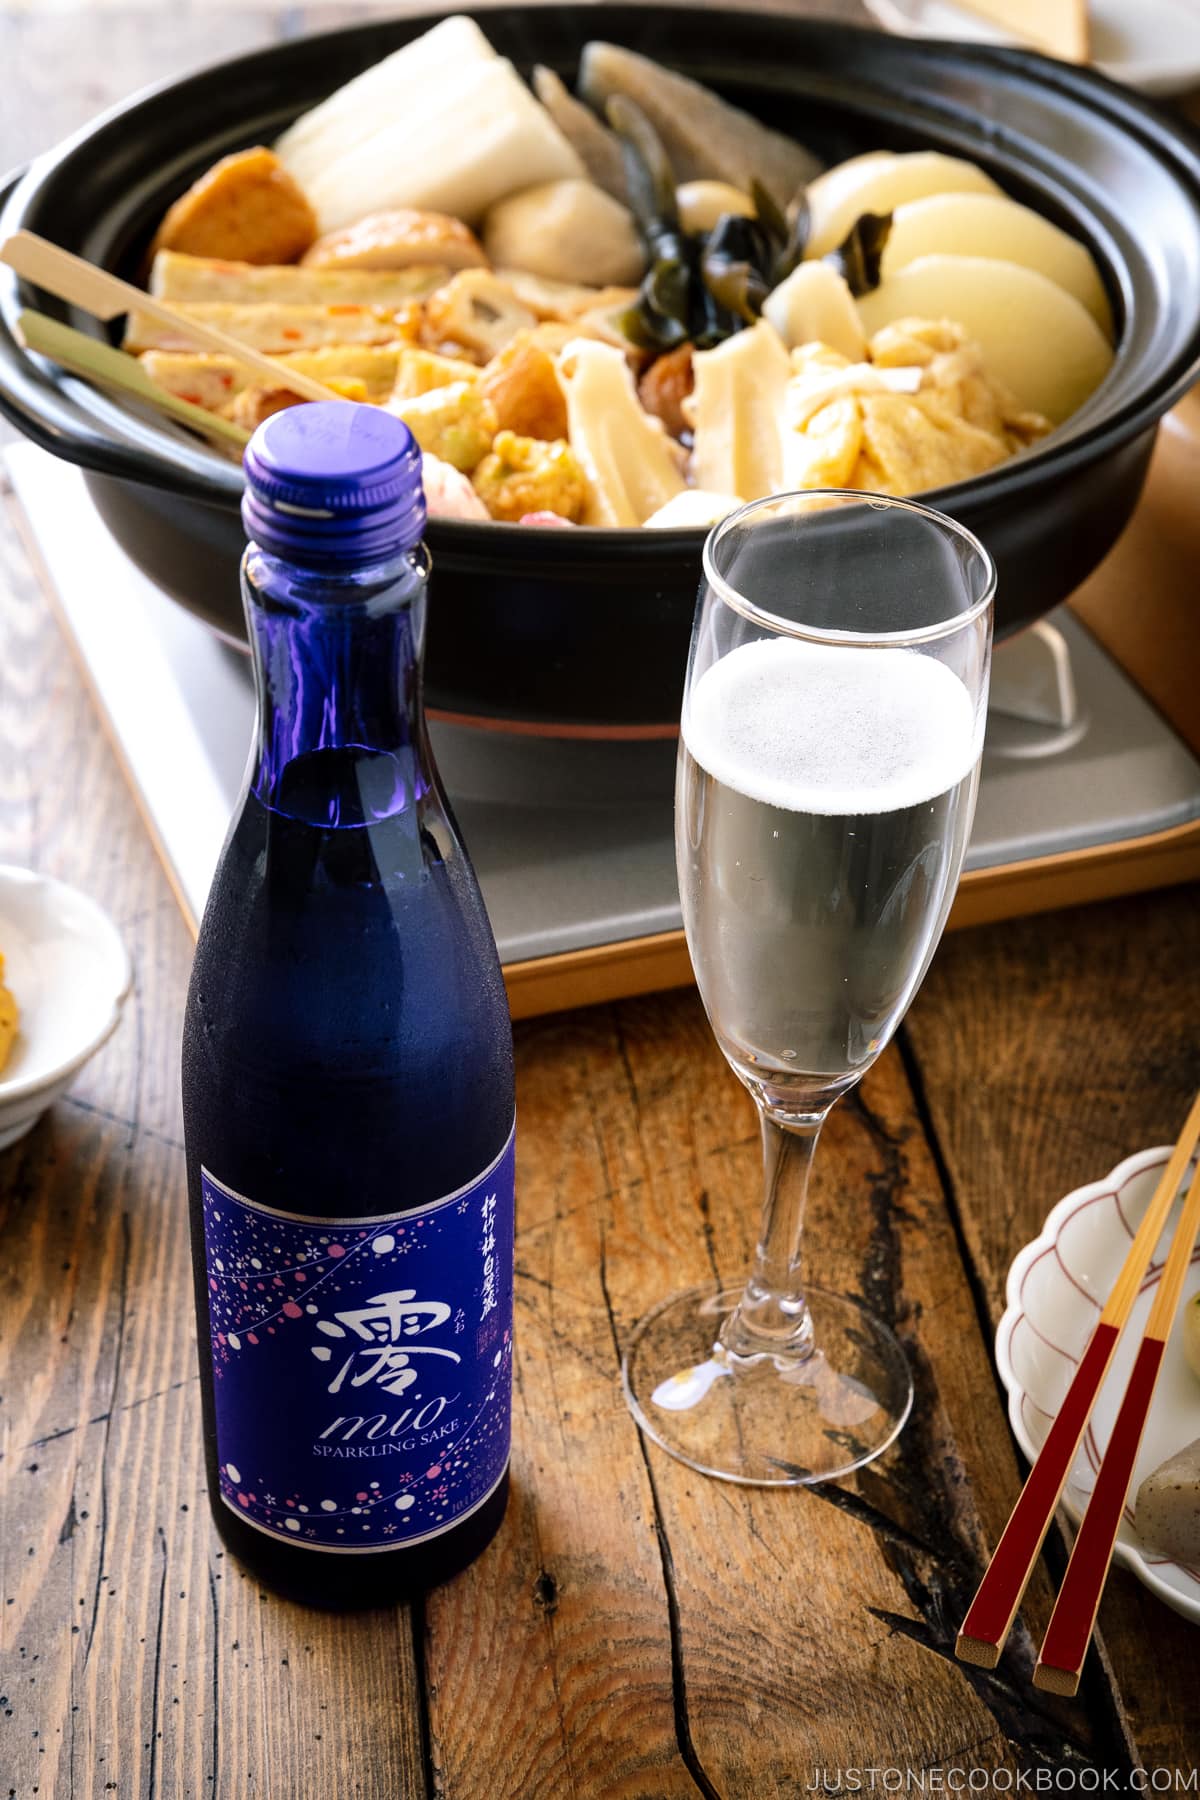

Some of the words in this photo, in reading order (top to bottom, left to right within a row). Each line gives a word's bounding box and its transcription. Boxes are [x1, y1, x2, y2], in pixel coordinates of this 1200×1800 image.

[311, 1289, 462, 1397] 澪
[454, 1308, 465, 1334] みお
[312, 1438, 417, 1458] SPARKLING
[420, 1418, 460, 1445] SAKE
[319, 1392, 461, 1440] mio
